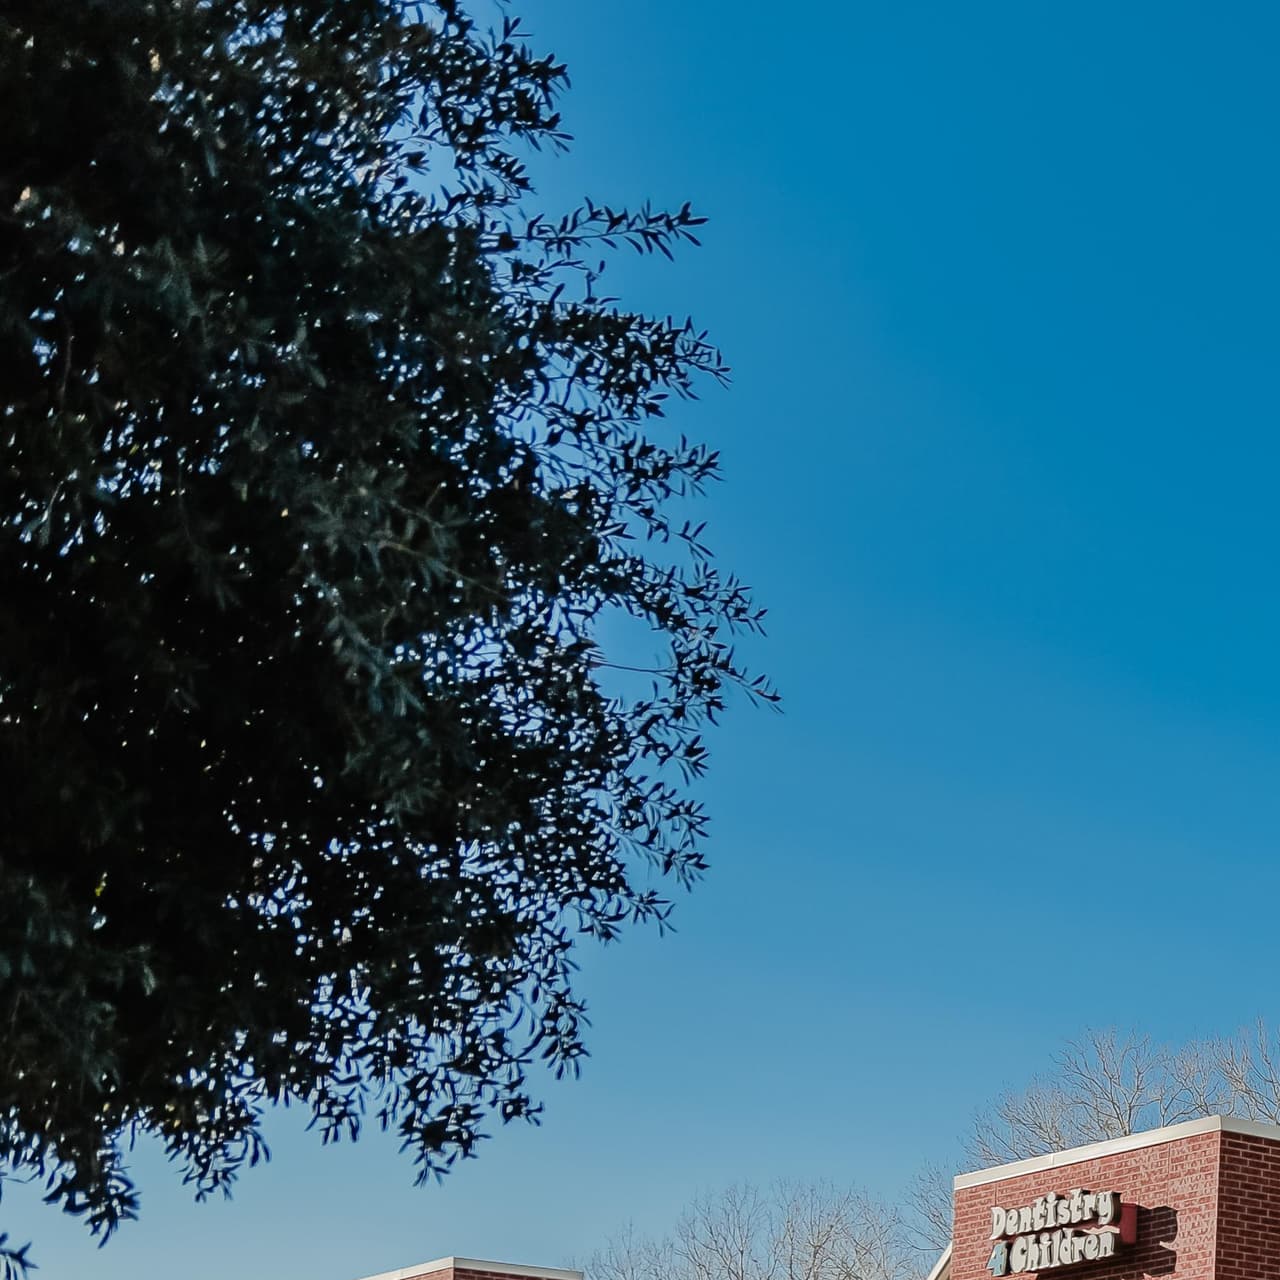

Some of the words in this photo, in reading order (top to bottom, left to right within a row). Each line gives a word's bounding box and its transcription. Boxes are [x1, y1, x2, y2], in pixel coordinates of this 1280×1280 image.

[989, 1188, 1114, 1240] Dentistry
[987, 1240, 1007, 1277] 4
[1010, 1228, 1114, 1273] Children
